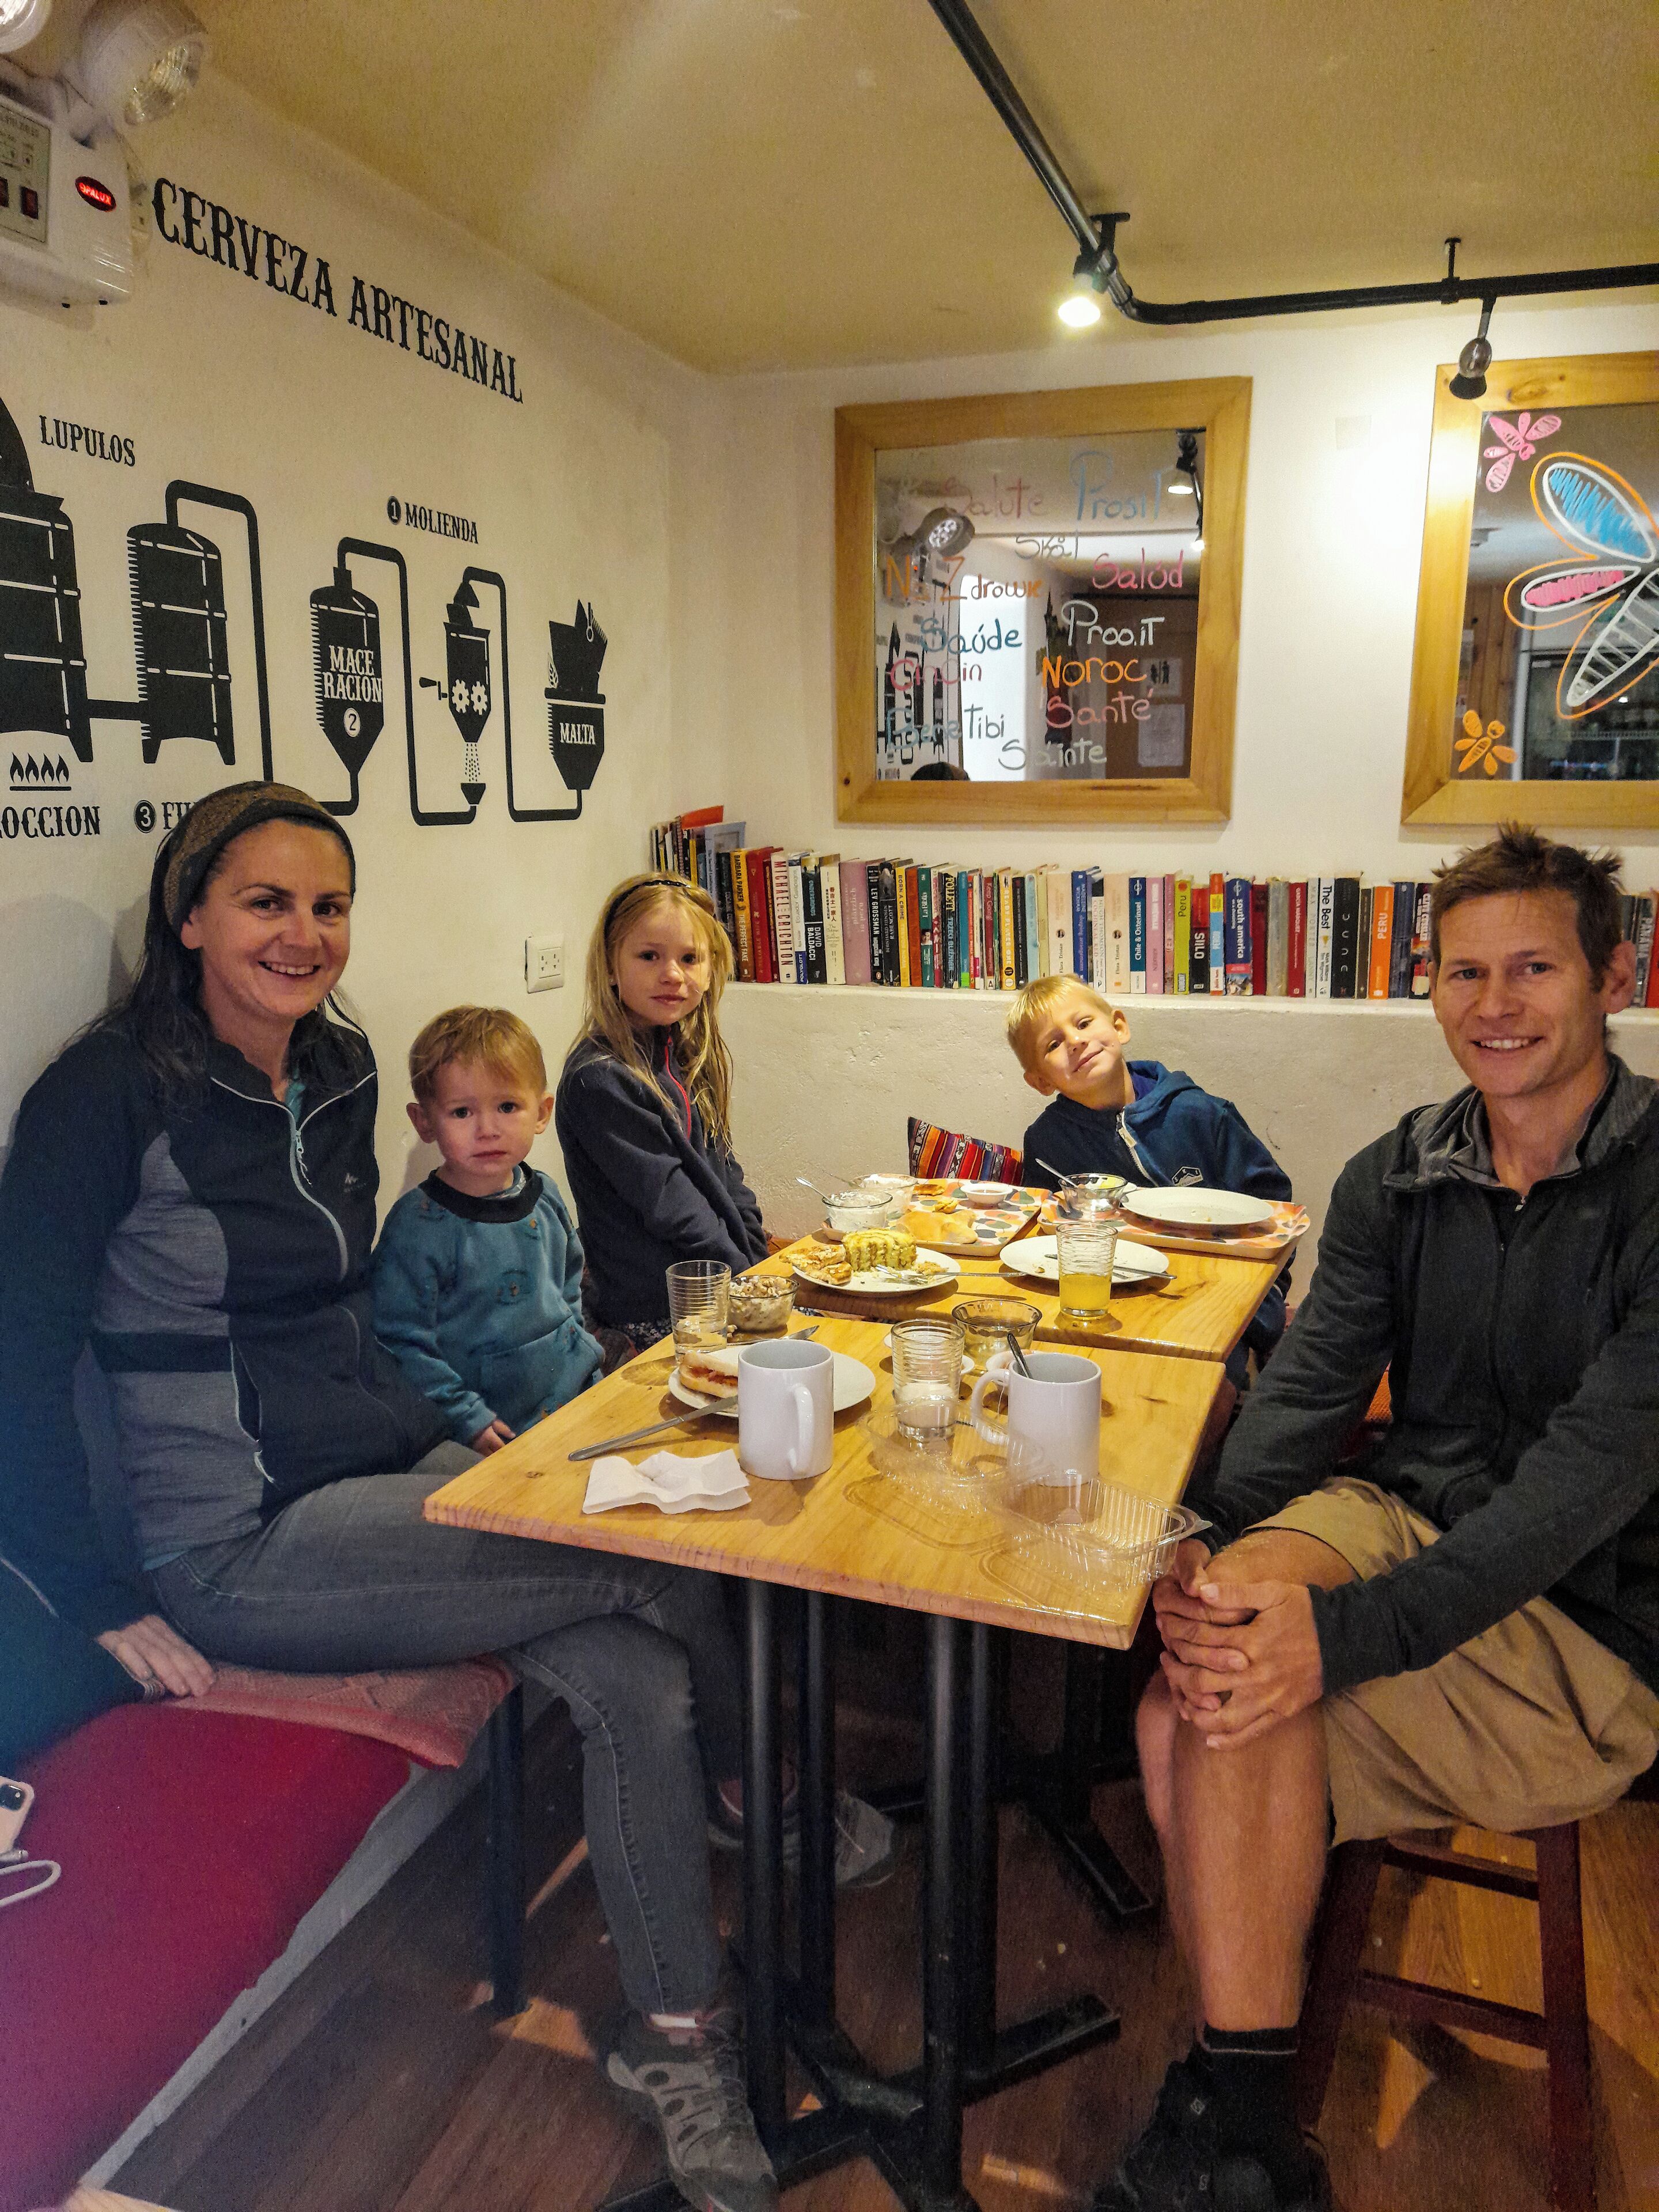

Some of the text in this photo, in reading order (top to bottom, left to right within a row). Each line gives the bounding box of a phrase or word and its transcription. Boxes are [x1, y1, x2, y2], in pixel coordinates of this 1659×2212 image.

[151, 178, 523, 403] CERVEZA ARTESANAL
[39, 415, 136, 467] LUPULOS
[404, 502, 478, 544] MOLIENDA
[922, 618, 1022, 654] Saúde
[329, 645, 374, 676] MACE
[322, 672, 382, 703] RACION
[1046, 690, 1154, 729] Santé
[559, 722, 596, 745] MALTA
[0, 805, 101, 839] OCCION
[945, 877, 955, 911] FOLLETT
[1178, 896, 1186, 916] Peru
[1321, 887, 1332, 929] The Best
[774, 861, 793, 965] MICHAEL CRICHTON
[872, 902, 880, 934] GROSSMAN
[1377, 912, 1387, 939] PERU
[807, 927, 816, 960] BALDACCI
